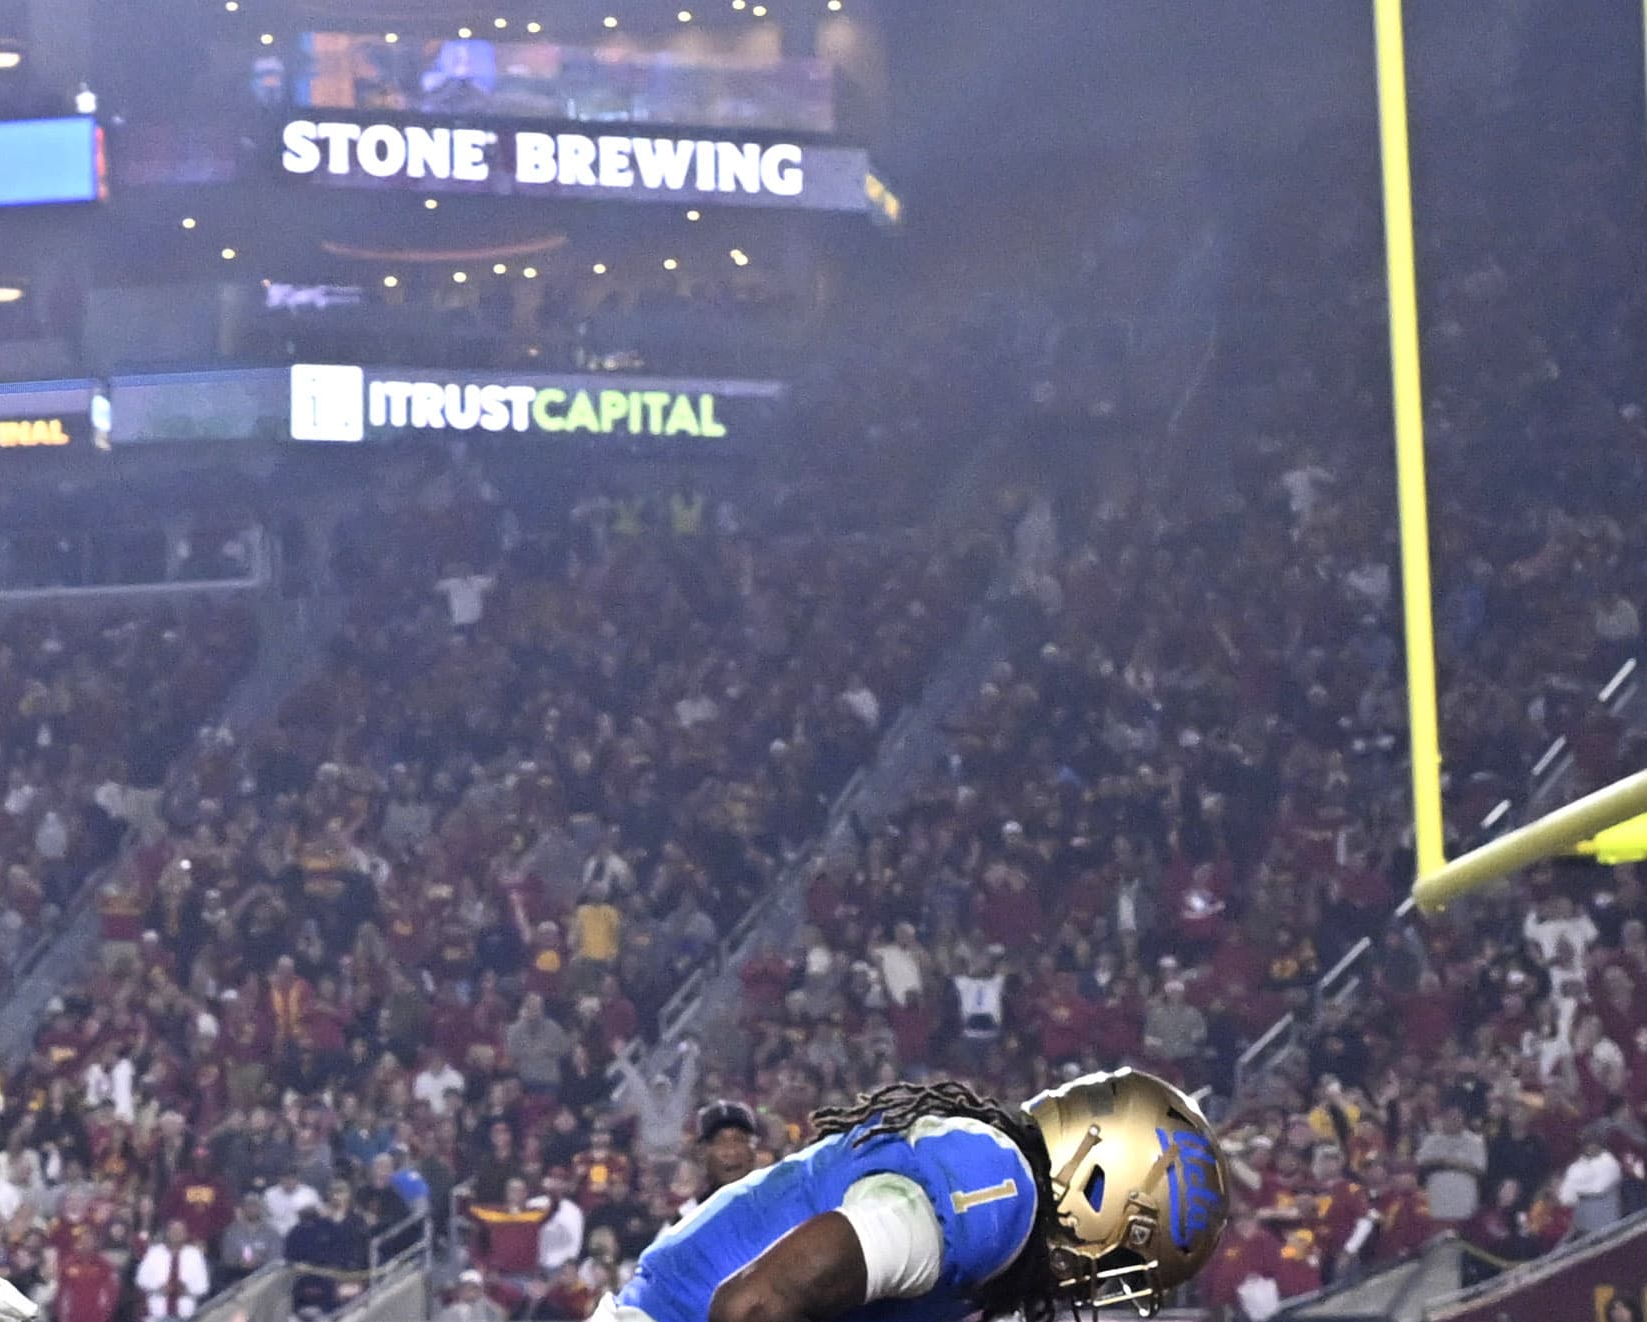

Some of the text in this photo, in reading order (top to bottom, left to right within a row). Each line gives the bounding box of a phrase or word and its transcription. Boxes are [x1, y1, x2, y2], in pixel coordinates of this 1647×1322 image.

[282, 120, 803, 196] STONE BREWING
[950, 1178, 1018, 1214] 1
